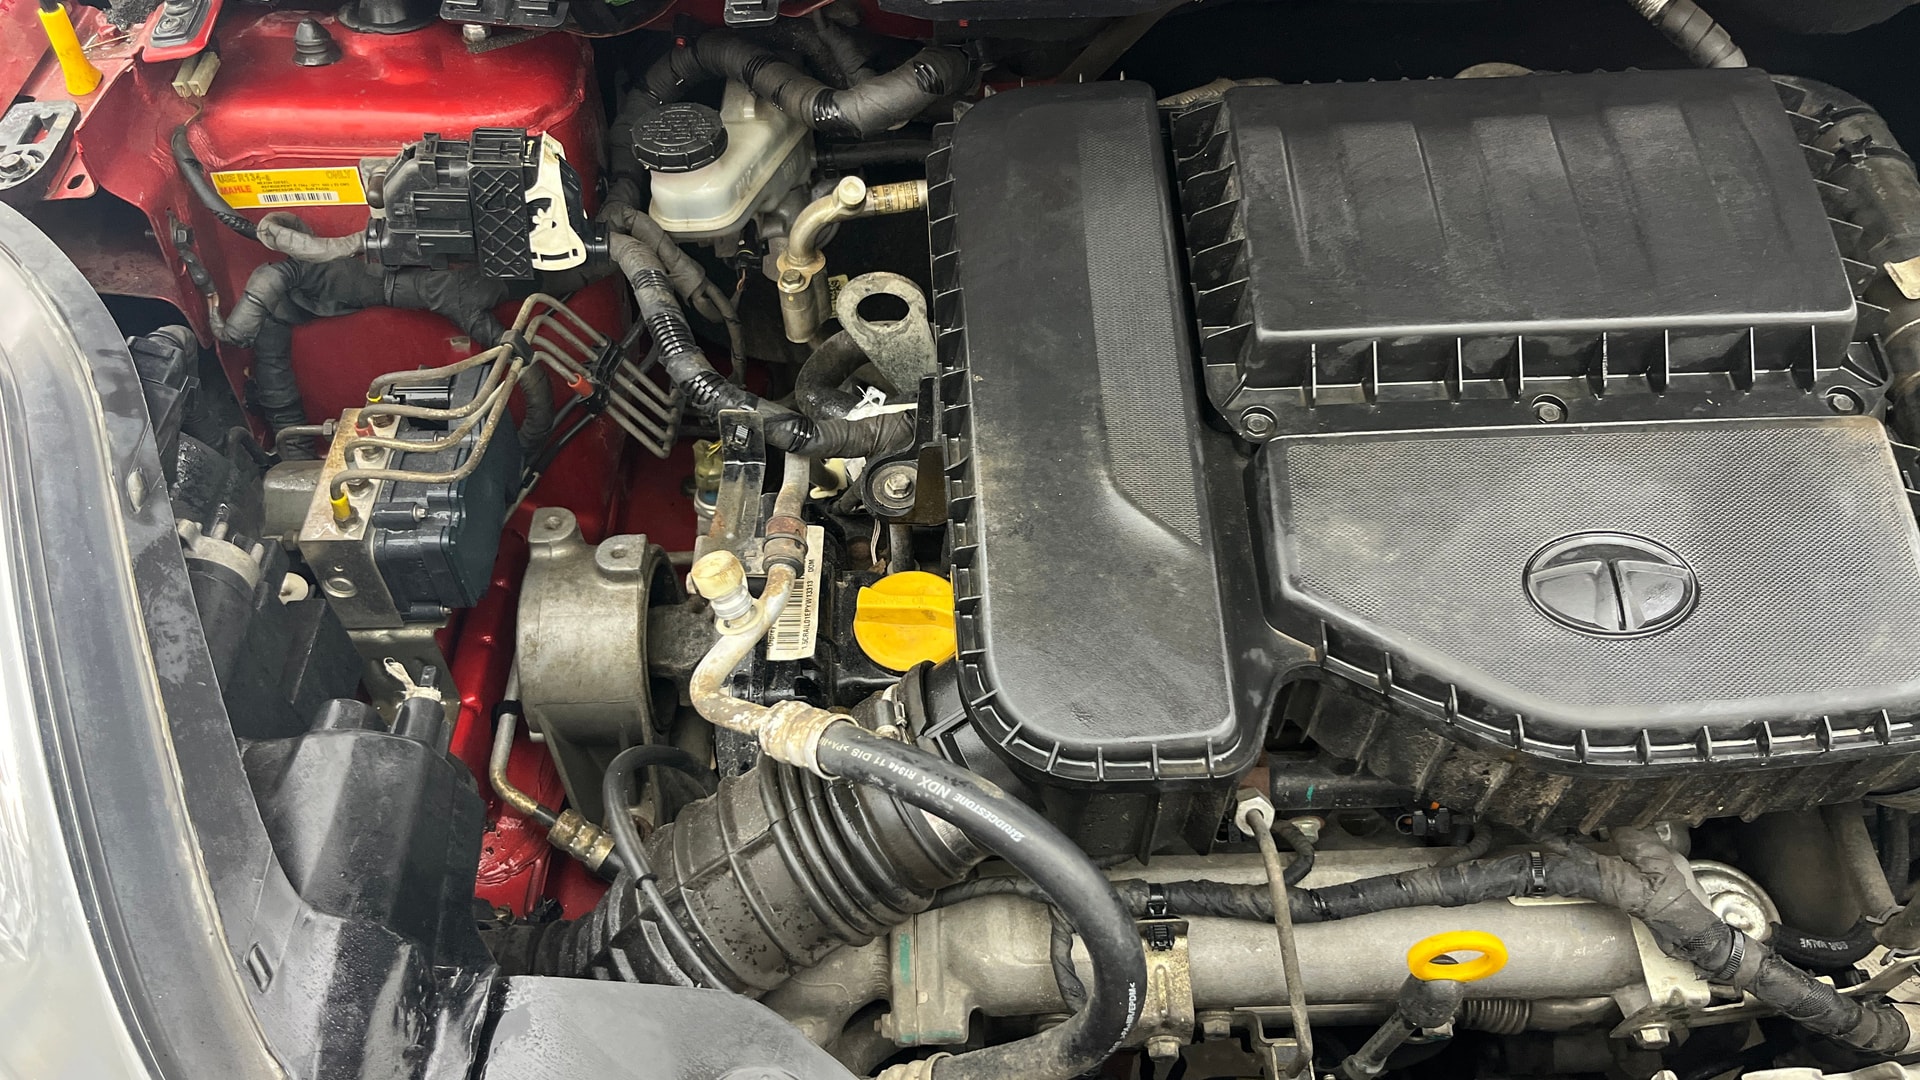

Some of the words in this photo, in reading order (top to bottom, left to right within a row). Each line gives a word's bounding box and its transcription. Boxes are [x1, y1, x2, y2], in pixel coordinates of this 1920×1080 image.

[217, 173, 237, 183] USE
[326, 169, 351, 180] ONLY
[220, 185, 252, 194] MAHLE
[917, 775, 952, 799] NDX
[952, 793, 1025, 842] BRIDGESTONE
